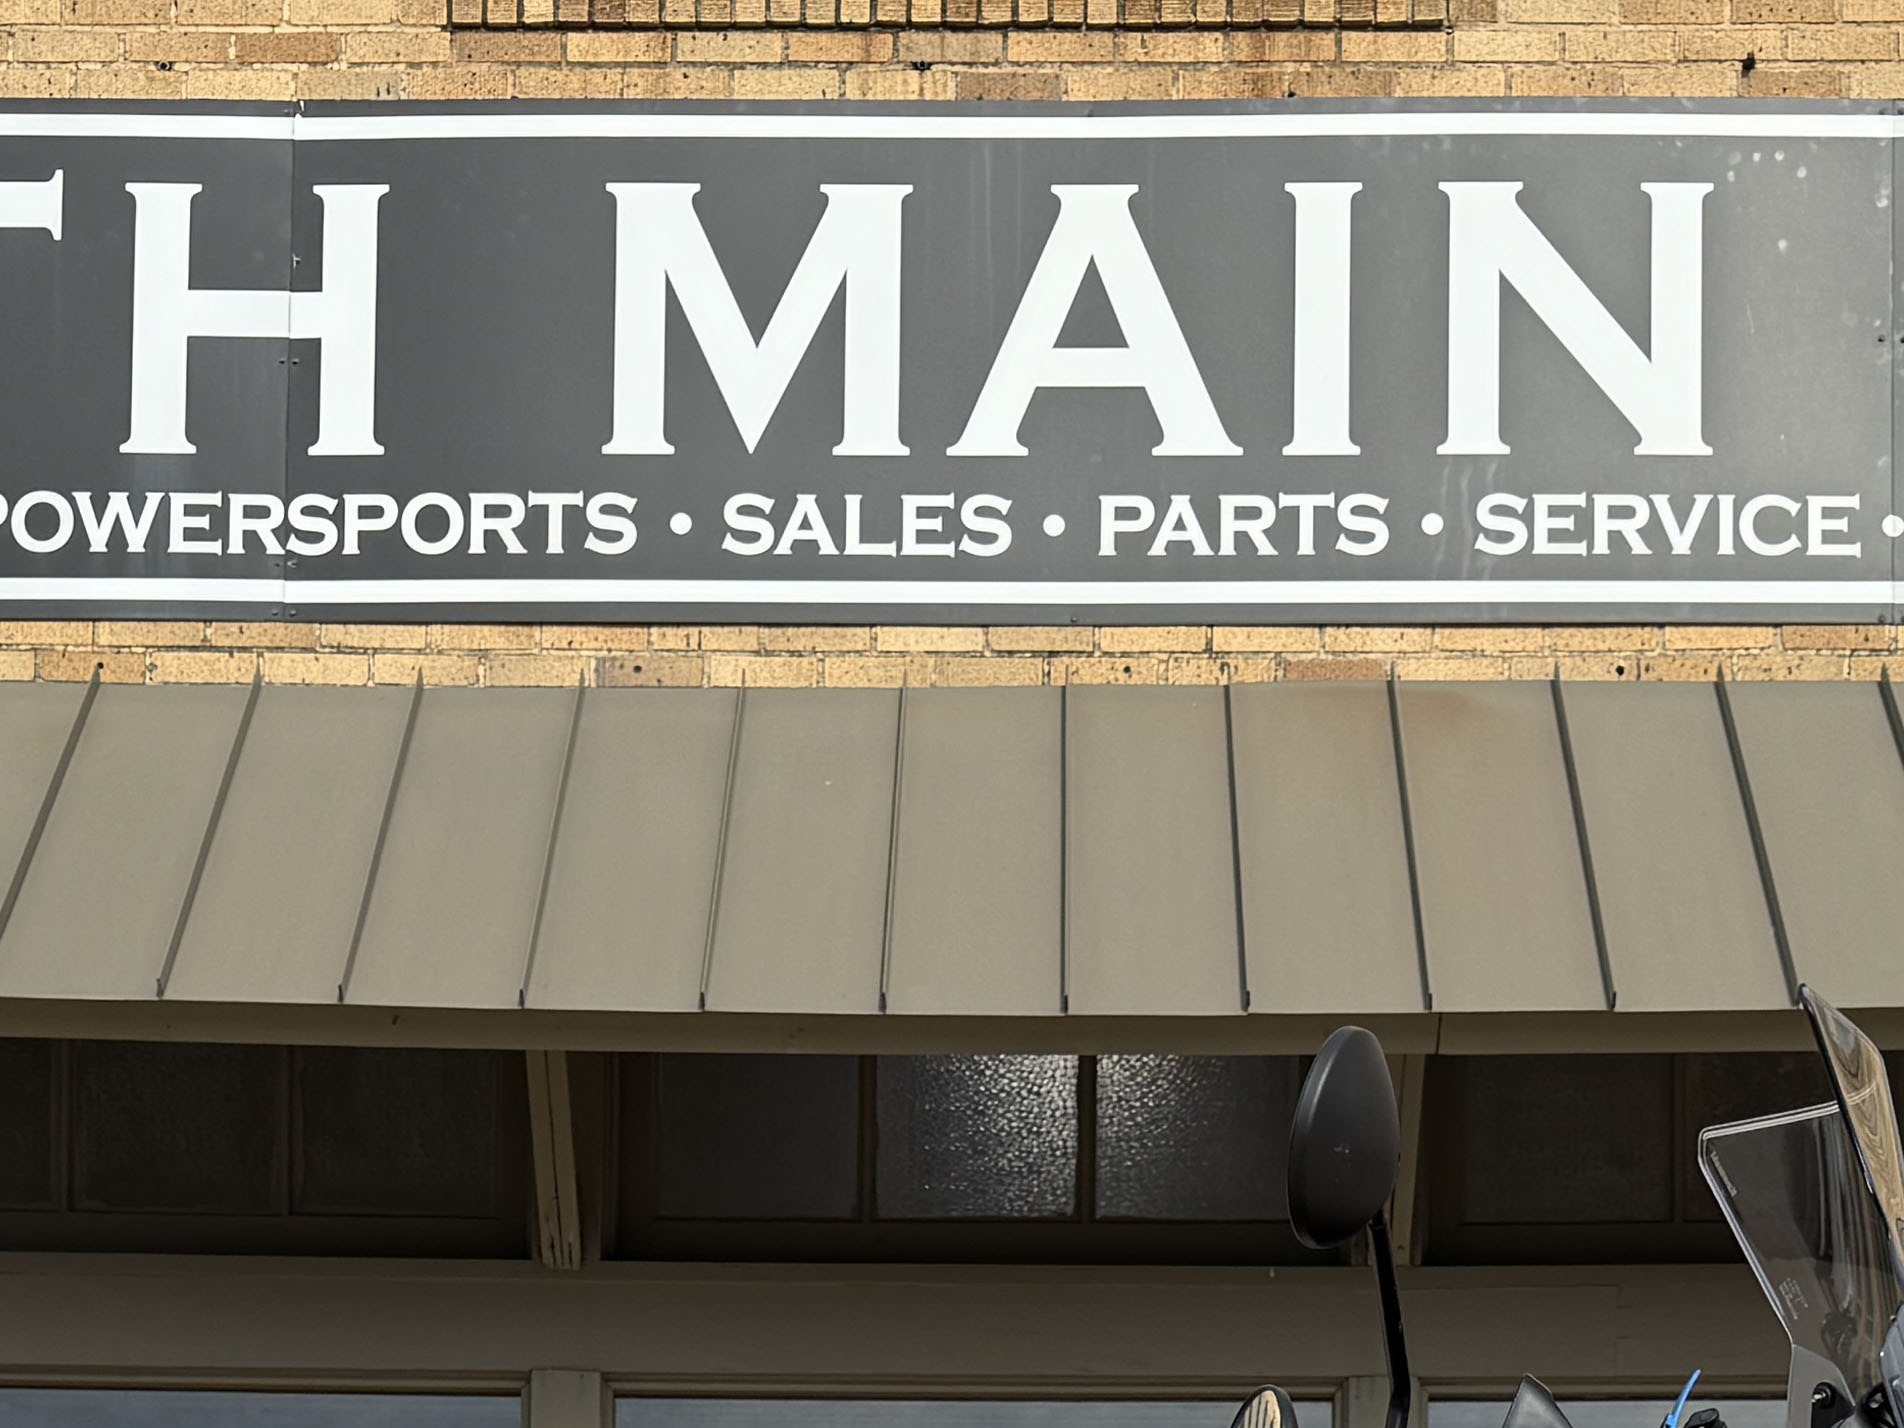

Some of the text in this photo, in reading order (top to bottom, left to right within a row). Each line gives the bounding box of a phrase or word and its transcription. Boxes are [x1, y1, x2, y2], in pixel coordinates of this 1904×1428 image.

[601, 180, 1715, 457] MAIN
[720, 491, 1014, 558] SALES
[1097, 490, 1391, 558] PARTS
[1472, 489, 1863, 560] SERVICE
